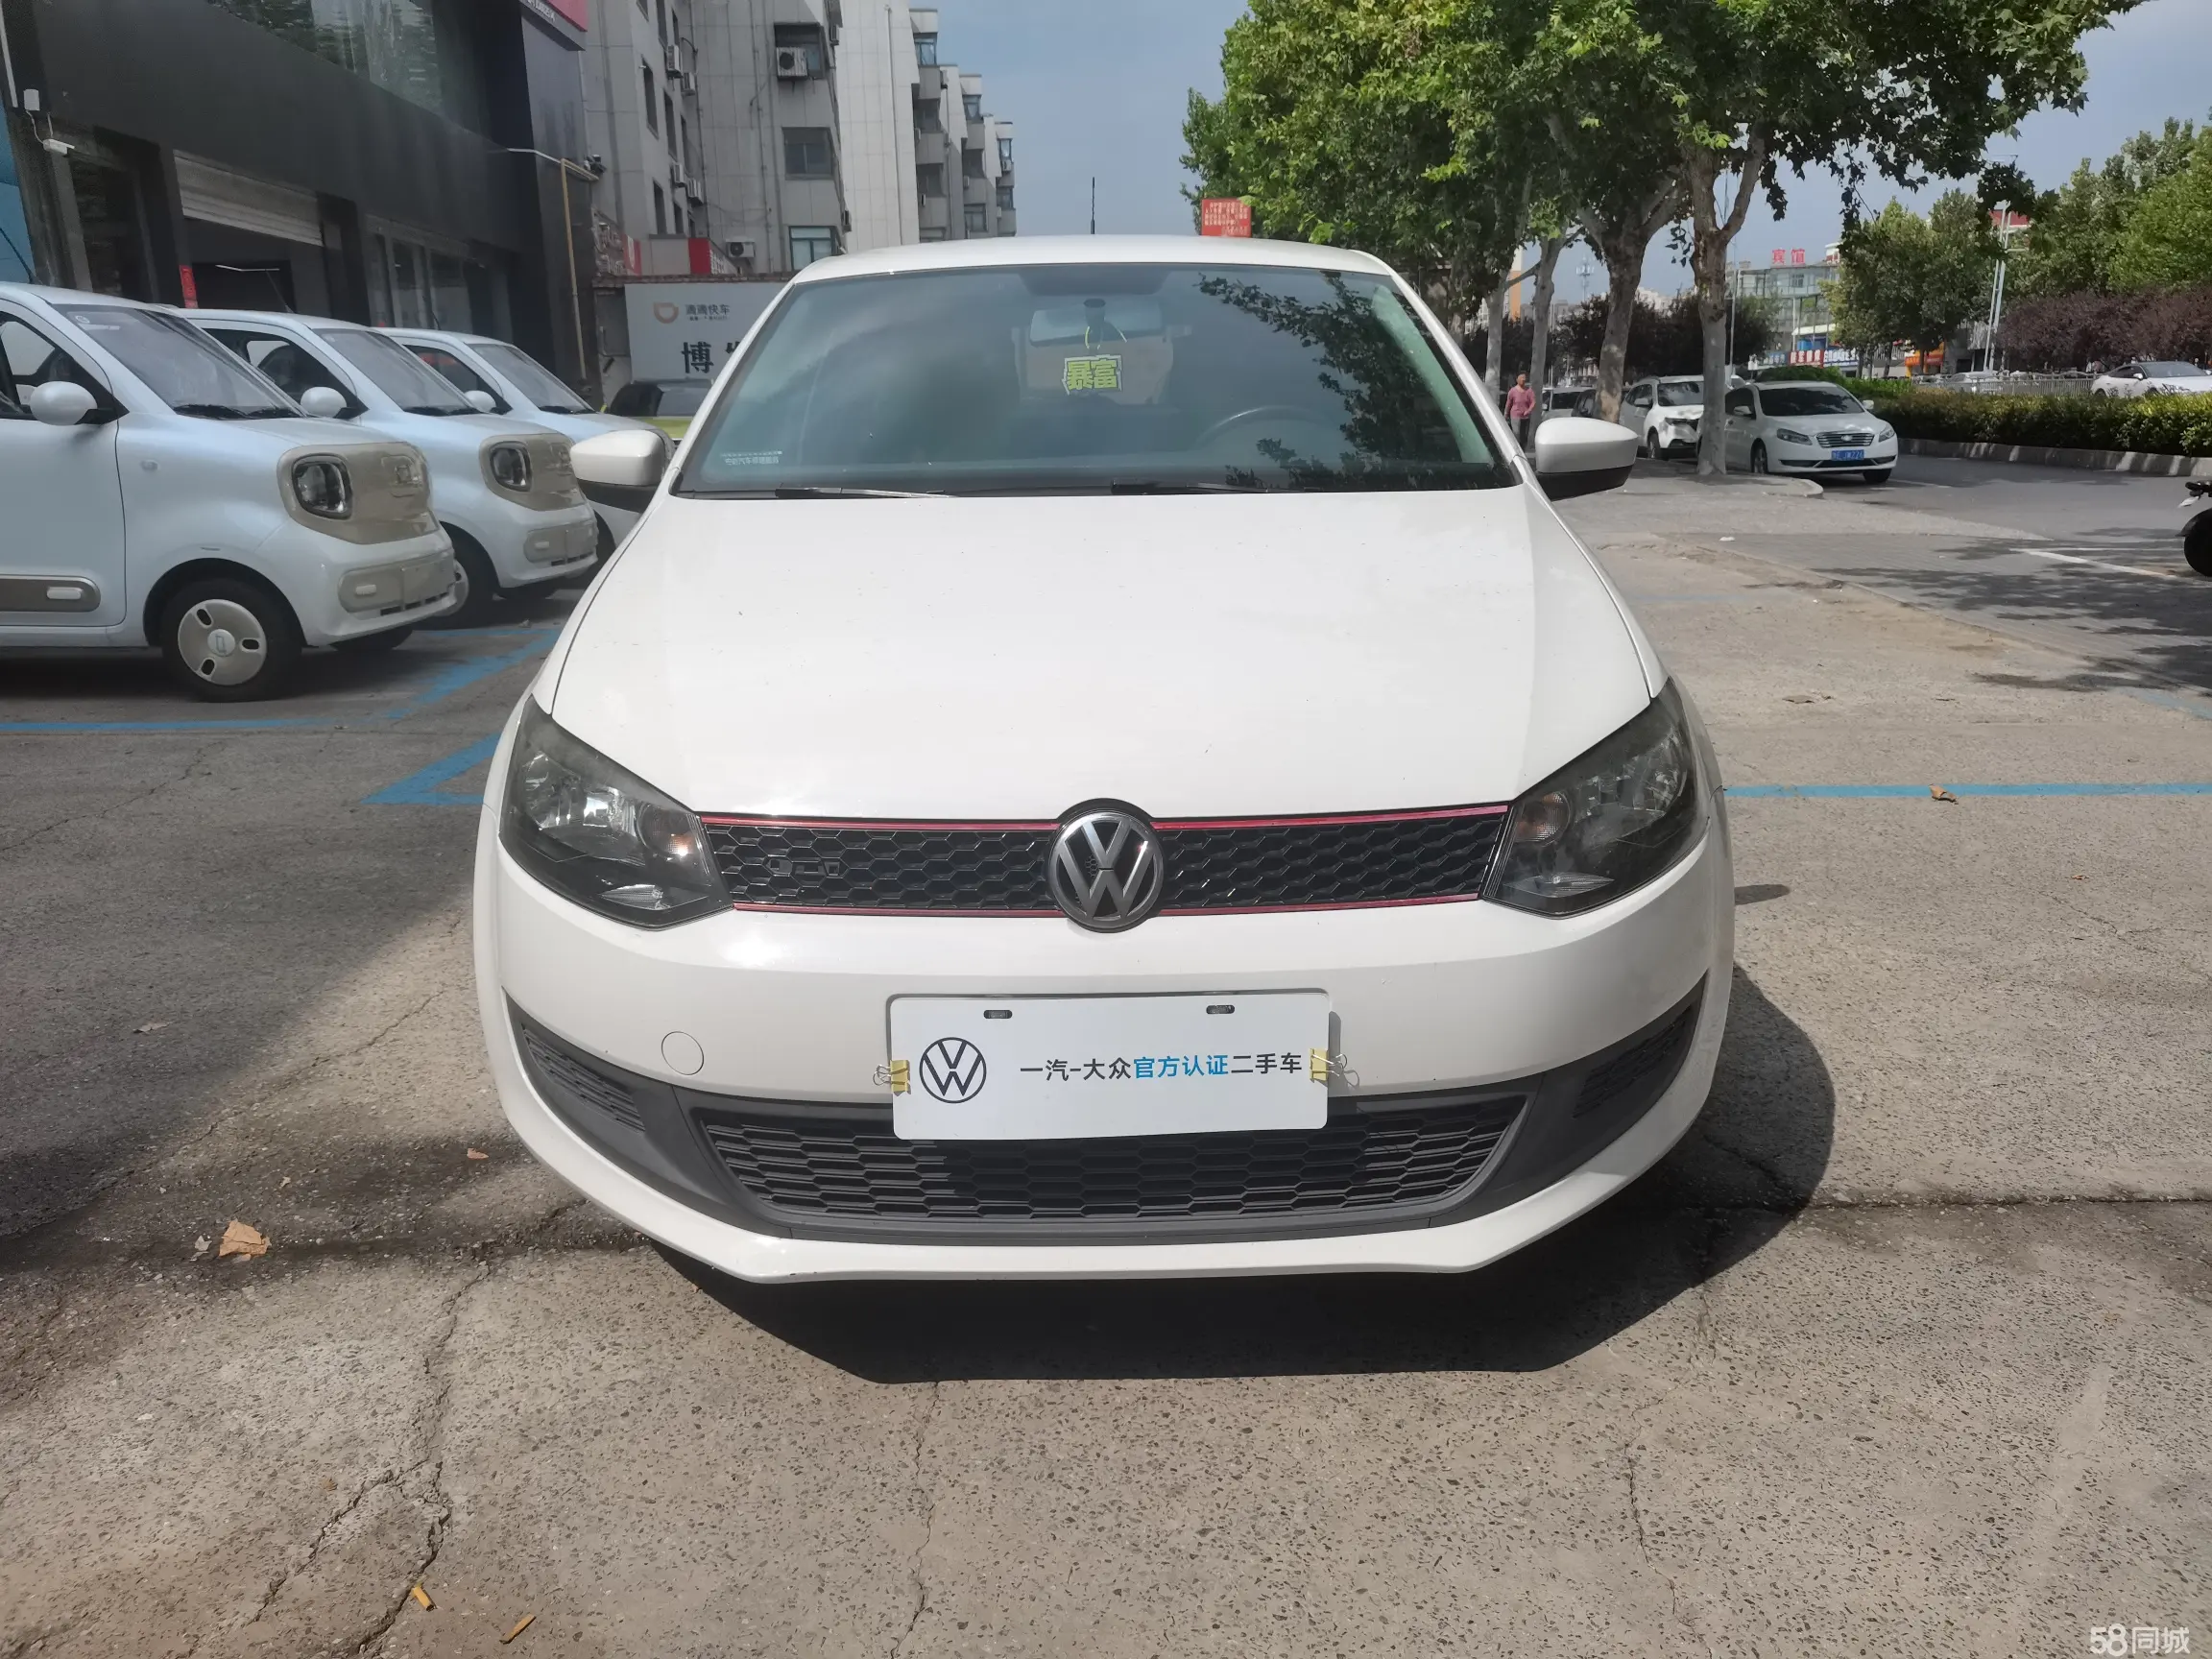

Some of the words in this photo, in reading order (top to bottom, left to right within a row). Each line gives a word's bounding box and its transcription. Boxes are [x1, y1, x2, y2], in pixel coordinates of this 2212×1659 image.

[1772, 248, 1805, 264] 宾馆
[681, 341, 741, 374] 博
[1067, 358, 1118, 391] 暴富
[1048, 811, 1164, 928] VW
[919, 1037, 987, 1104] VW
[1020, 1051, 1303, 1083] 一汽-大众官方认证二手车
